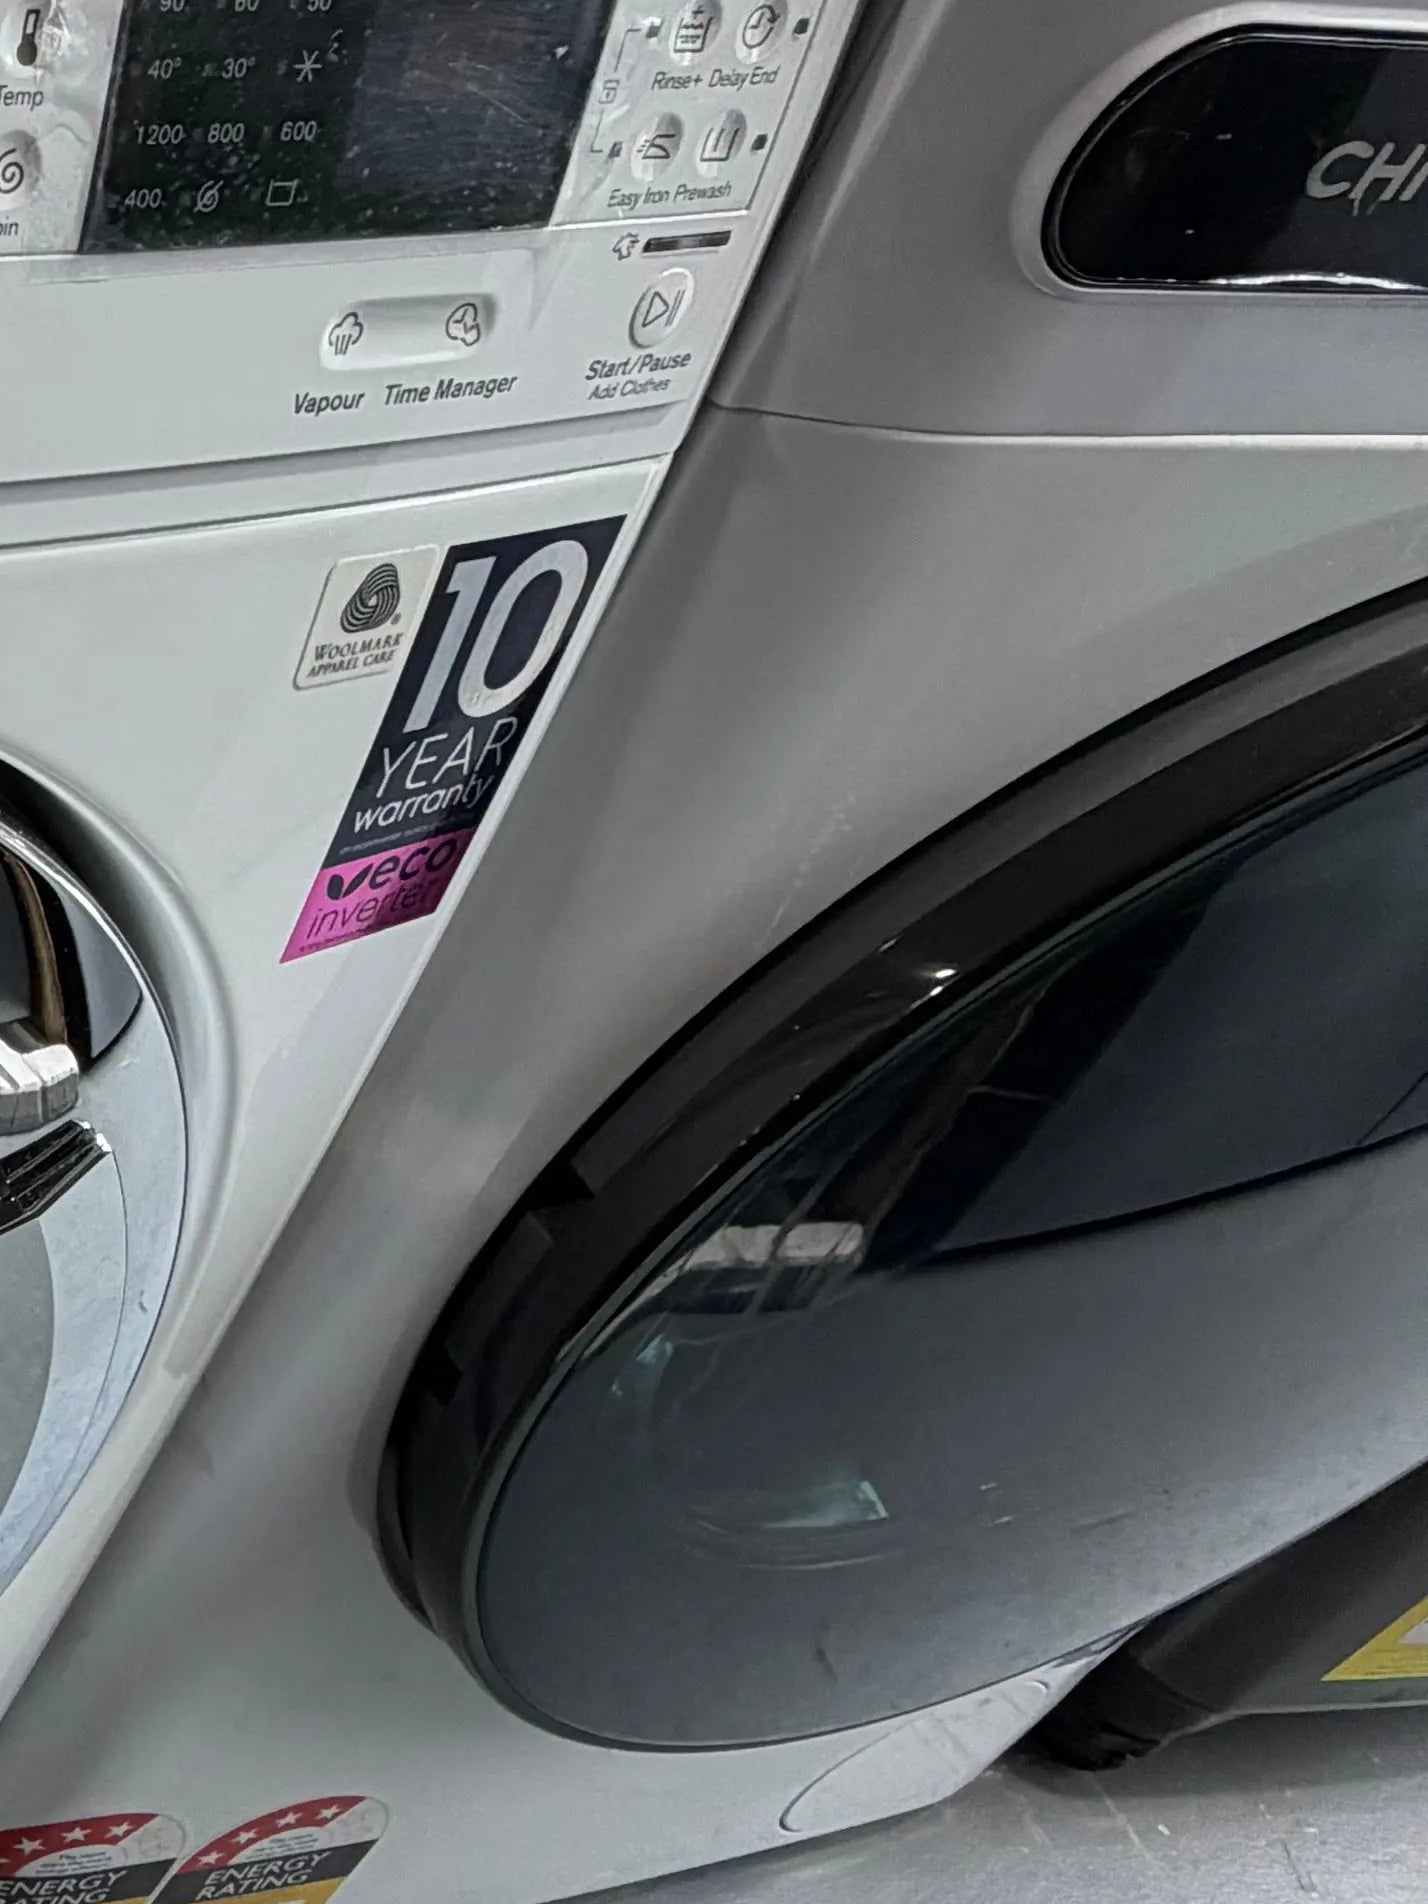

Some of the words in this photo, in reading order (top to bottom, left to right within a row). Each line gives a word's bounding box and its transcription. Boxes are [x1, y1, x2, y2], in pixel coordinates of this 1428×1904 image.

[708, 69, 752, 91] Delay
[749, 65, 781, 85] End
[135, 124, 186, 145] 1200
[207, 122, 245, 144] 800
[280, 120, 318, 142] 600
[124, 188, 162, 210] 400
[607, 186, 645, 211] Easy
[585, 351, 692, 381] Start/Pause
[293, 391, 365, 417] Vapour
[384, 383, 429, 407] Time
[435, 373, 518, 401] Manager
[587, 382, 619, 401] Add
[620, 377, 671, 398] Clothes
[315, 632, 404, 661] WOOLMARK
[402, 540, 589, 733] 10
[376, 717, 518, 799] YEAR
[354, 772, 494, 834] warranty
[369, 838, 458, 890] eco
[306, 879, 439, 939] inverter
[205, 1851, 333, 1885] ENERGY
[195, 1869, 313, 1901] RATING
